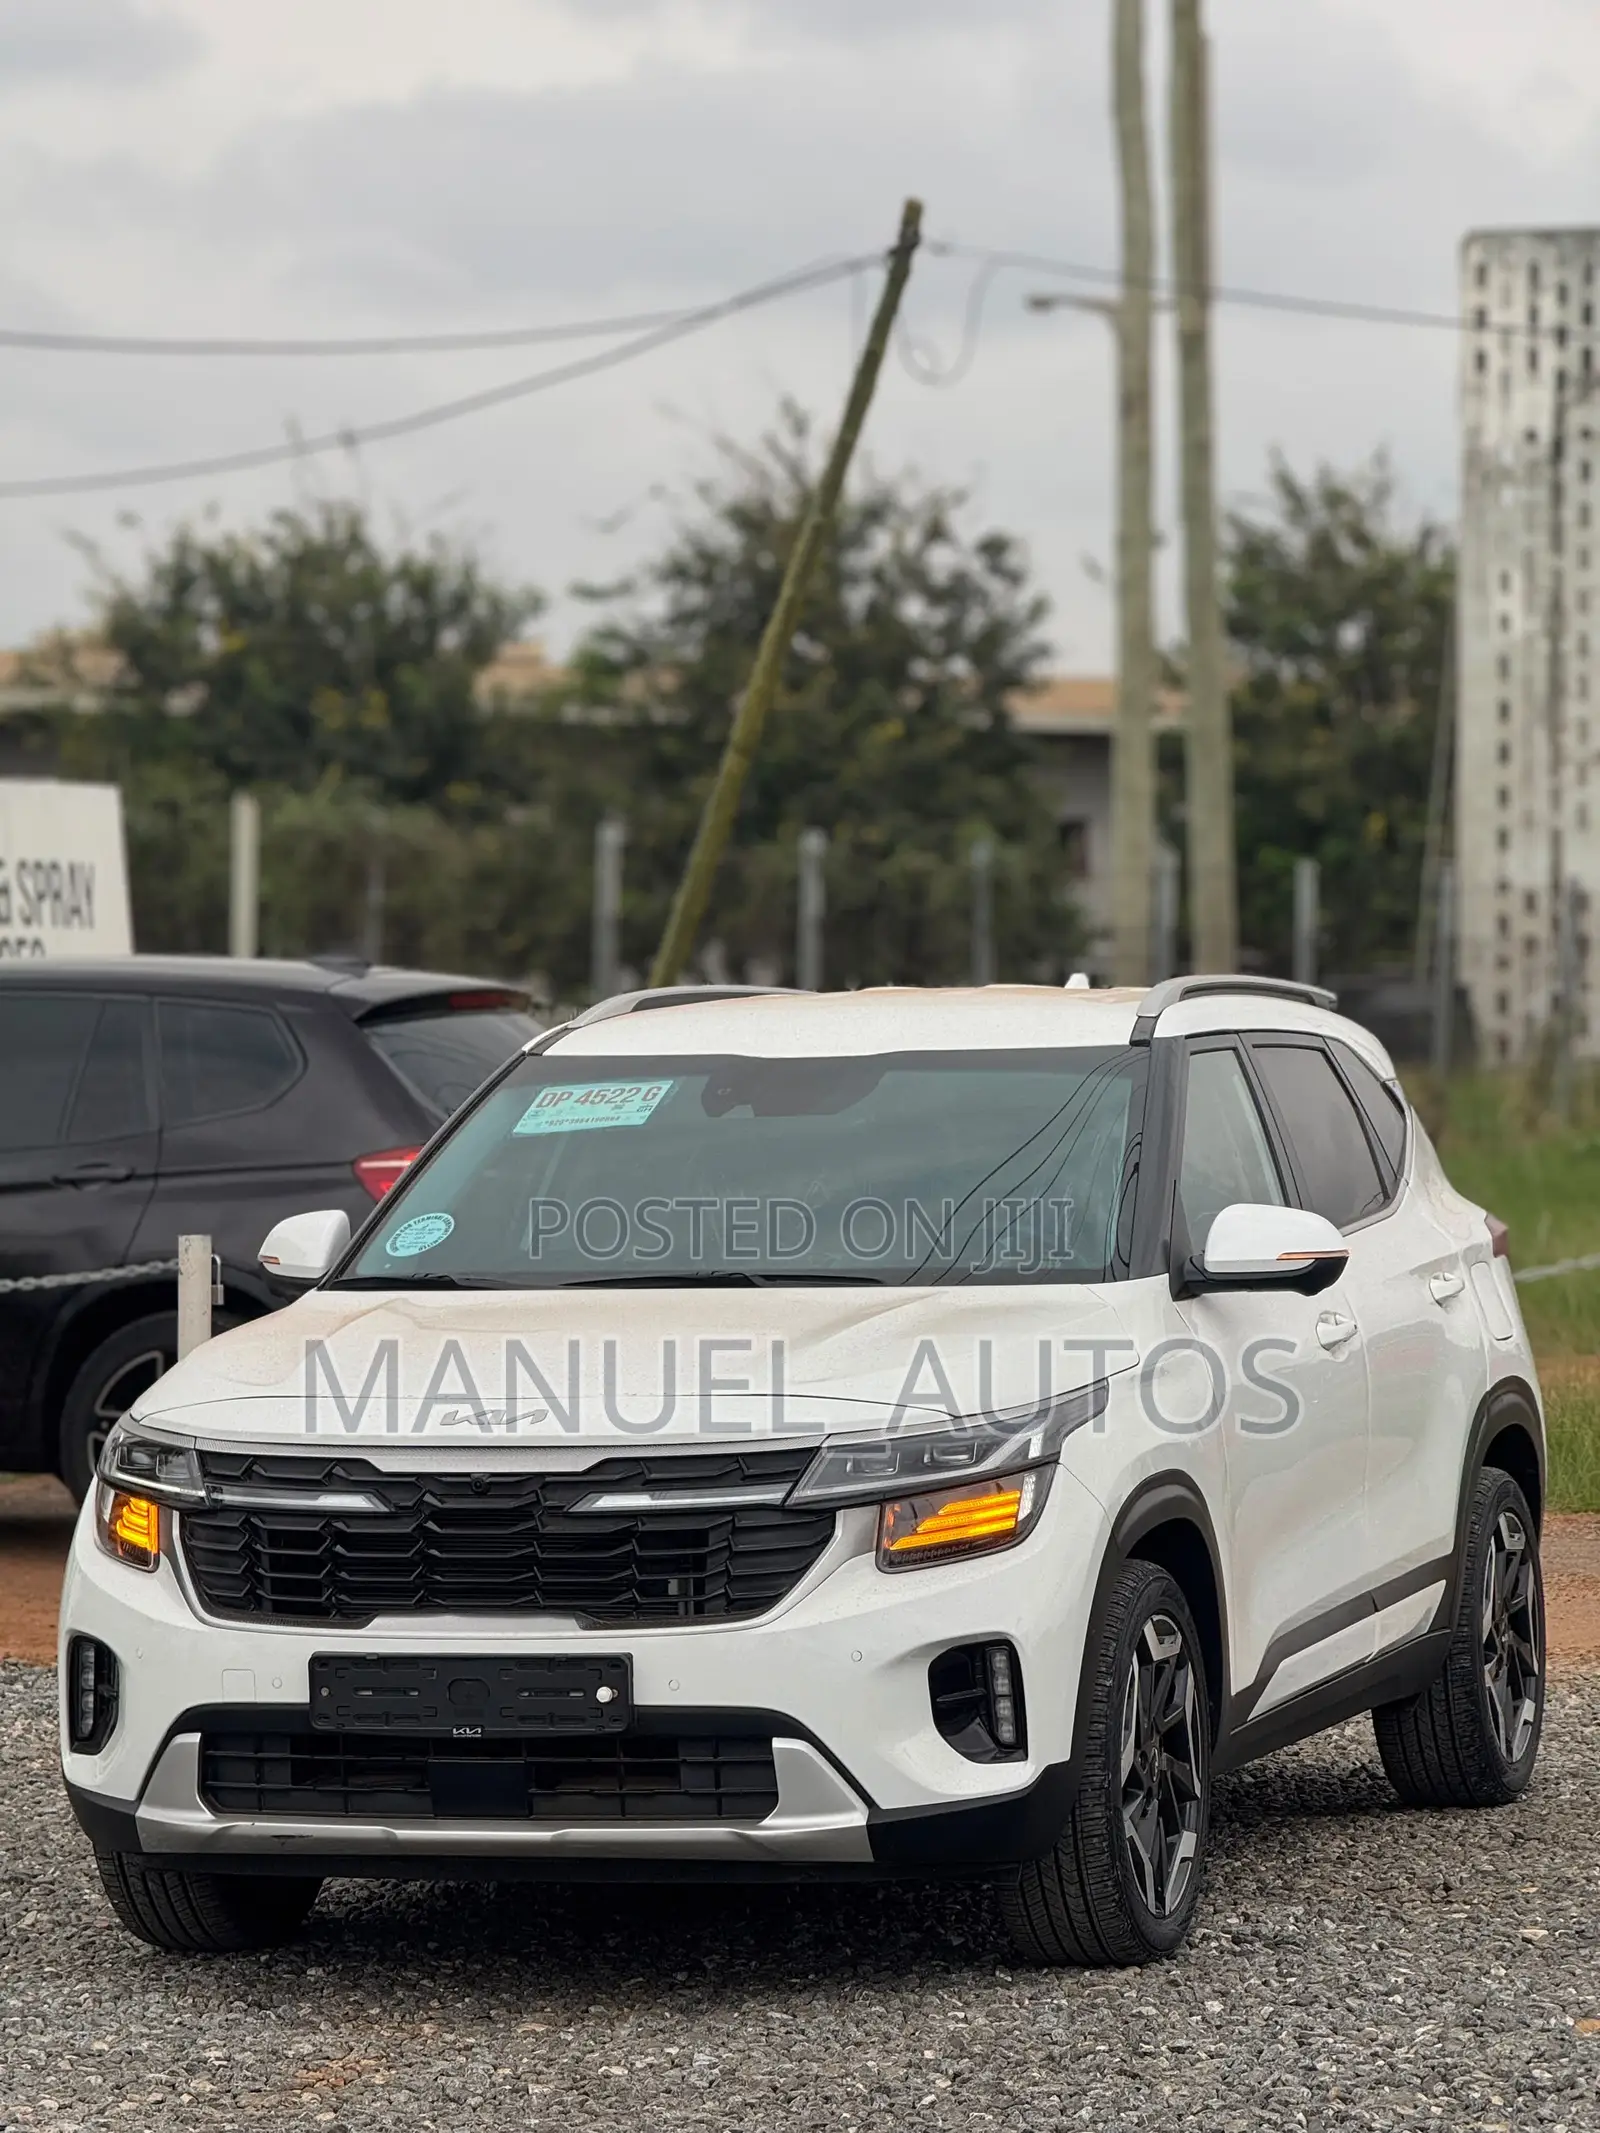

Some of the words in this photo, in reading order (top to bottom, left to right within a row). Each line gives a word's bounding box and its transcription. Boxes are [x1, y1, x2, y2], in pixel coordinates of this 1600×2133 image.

[17, 858, 96, 929] SPRAY
[535, 1091, 574, 1108] DP
[574, 1087, 641, 1105] 4522
[641, 1086, 662, 1101] G
